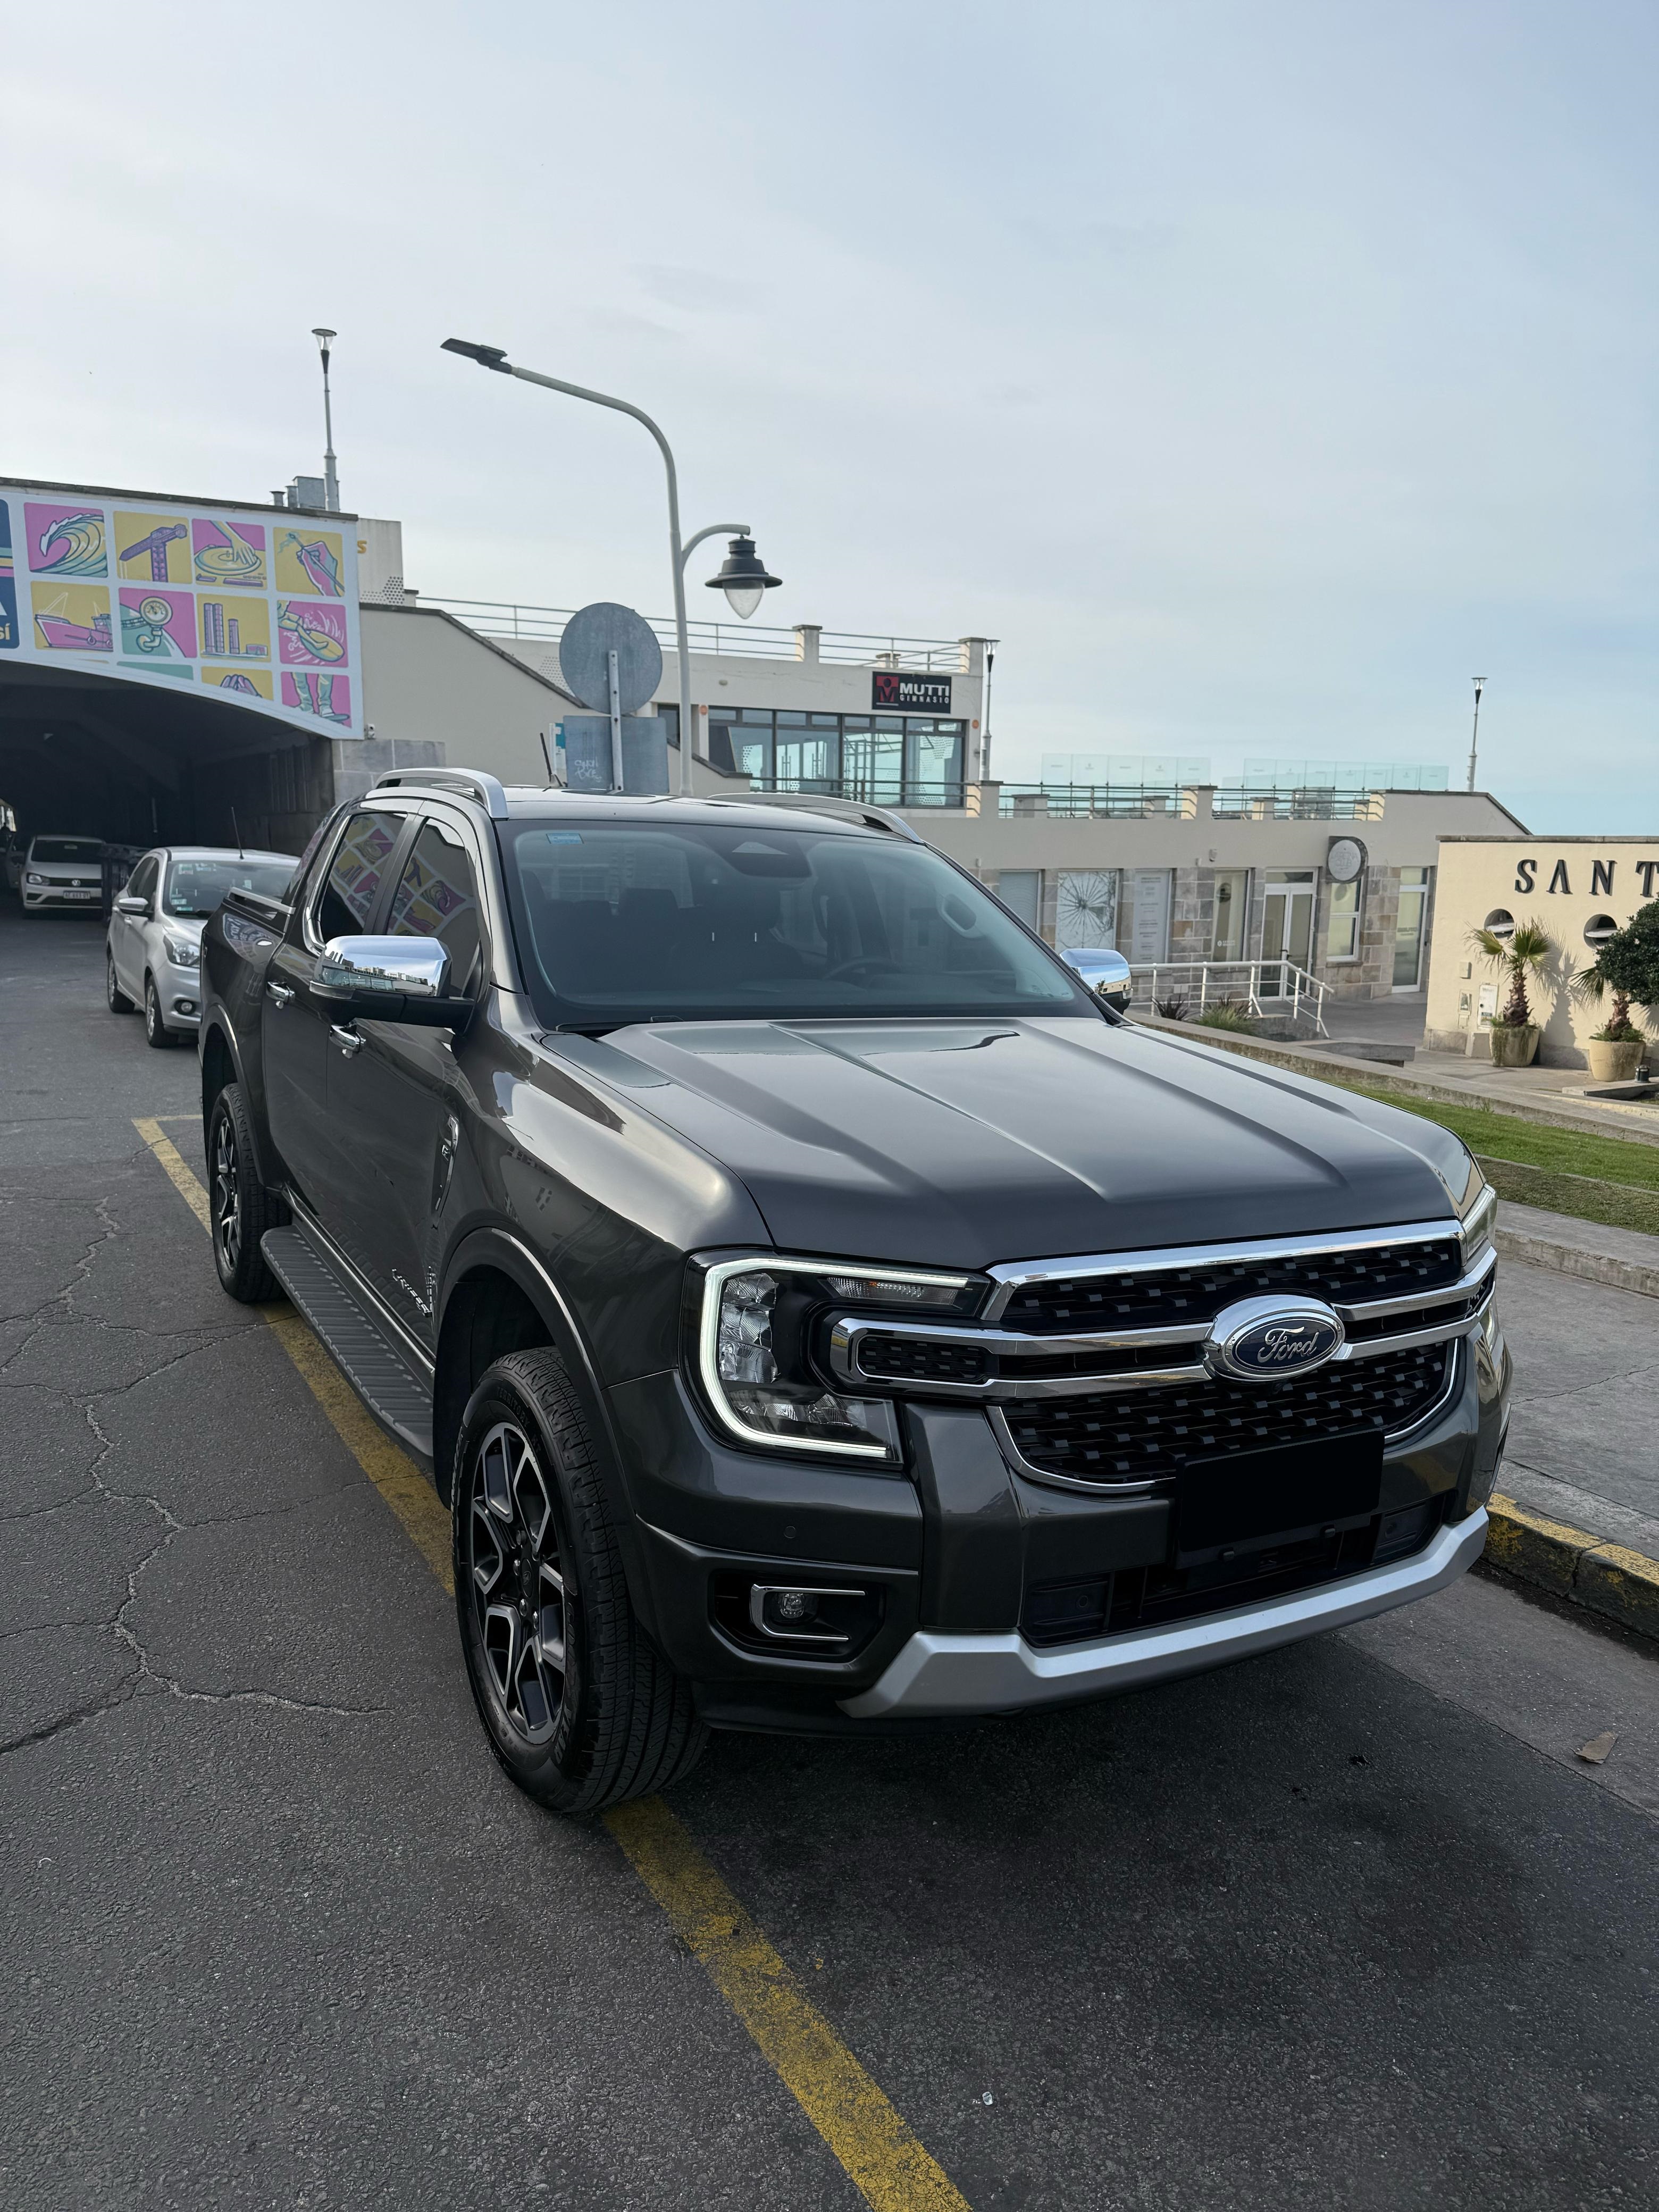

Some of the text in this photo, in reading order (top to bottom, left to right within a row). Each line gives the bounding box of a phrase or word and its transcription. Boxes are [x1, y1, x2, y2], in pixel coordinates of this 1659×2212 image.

[899, 683, 950, 696] MUTTI
[899, 694, 949, 703] GIMNASIO
[1257, 1326, 1319, 1363] Ford
[496, 1386, 530, 1427] TERRITORY
